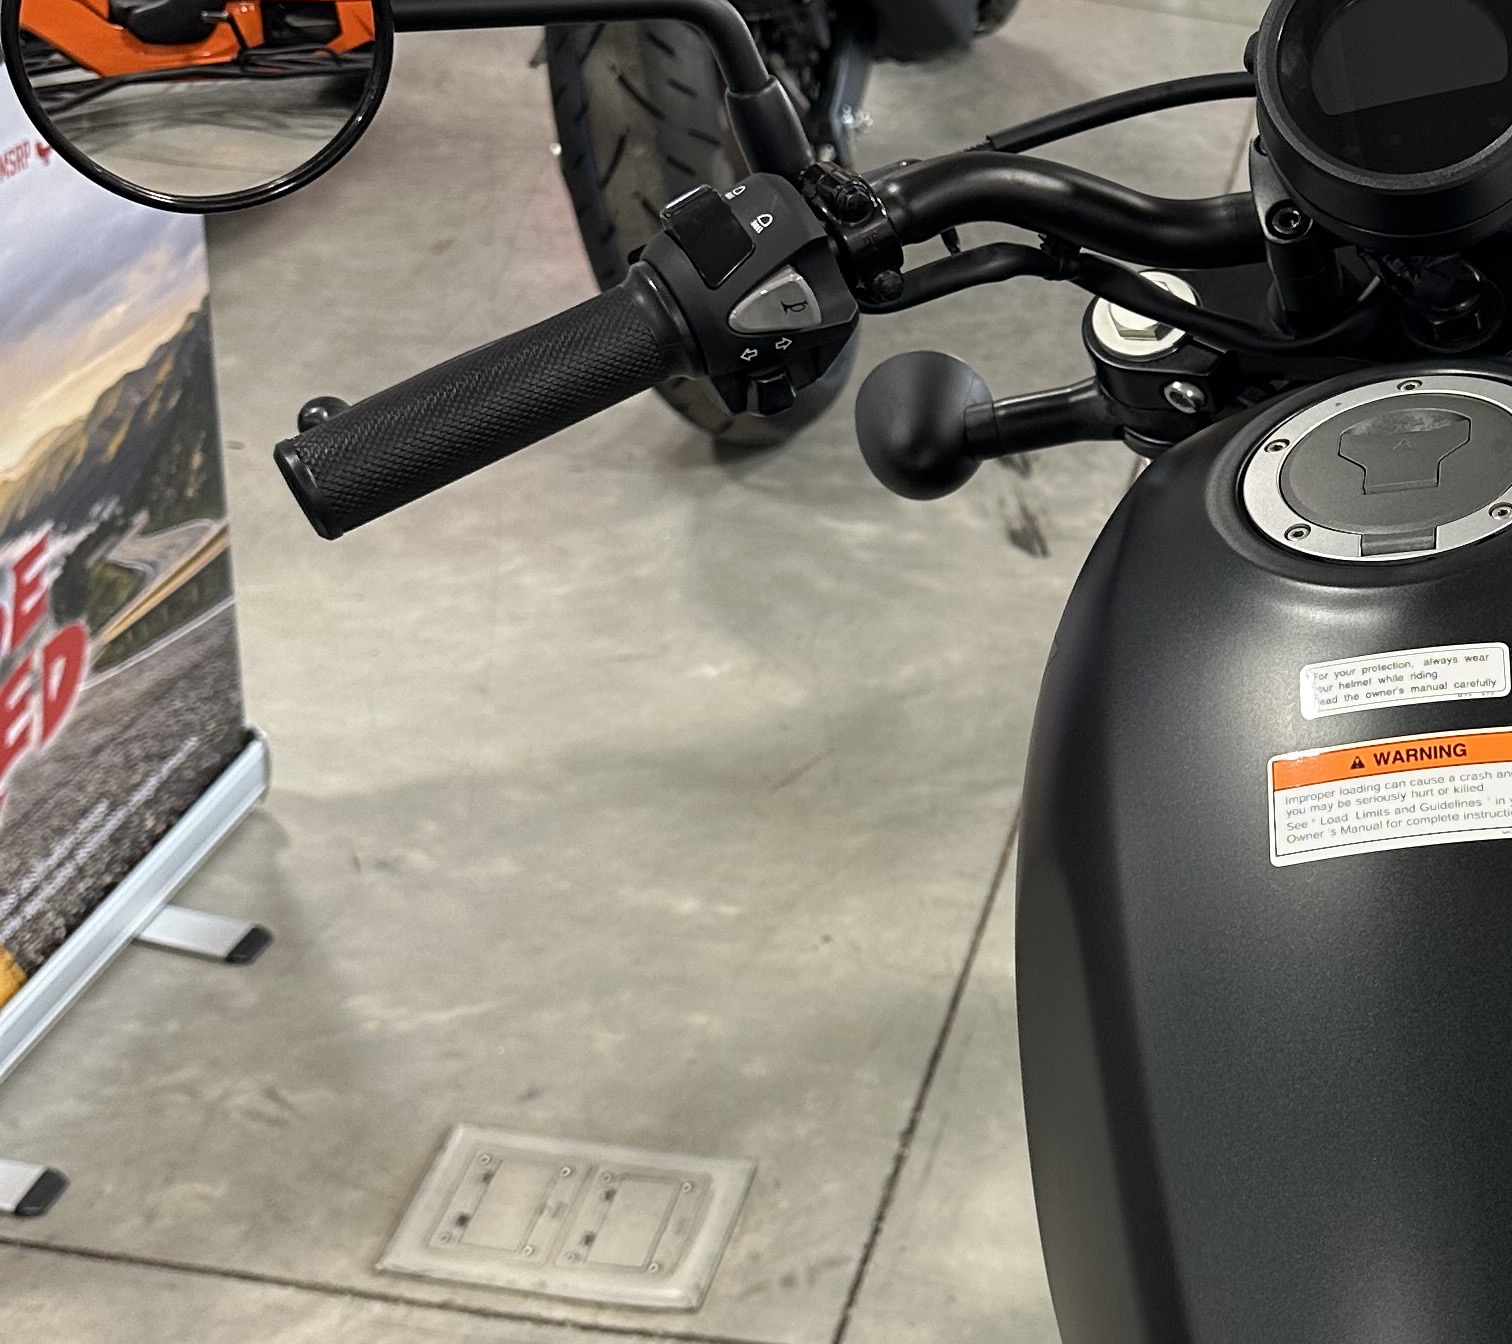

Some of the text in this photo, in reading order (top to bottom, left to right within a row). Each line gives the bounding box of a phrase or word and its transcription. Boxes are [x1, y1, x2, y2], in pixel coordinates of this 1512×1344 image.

[1313, 671, 1328, 682] For
[1334, 667, 1357, 680] your
[1424, 656, 1458, 667] always
[1464, 654, 1490, 662] wear
[1313, 684, 1333, 693] our
[1338, 678, 1372, 691] helmet
[1378, 674, 1404, 685] while
[1344, 692, 1360, 702] the
[1365, 686, 1405, 699] owner's
[1410, 682, 1448, 692] manual
[1453, 677, 1497, 690] carefully
[1373, 743, 1467, 766] WARNING
[1285, 790, 1336, 806] Improper
[1339, 782, 1381, 796] loading
[1385, 779, 1407, 790] can
[1410, 776, 1445, 787] cause
[1449, 775, 1456, 783] a
[1460, 771, 1492, 782] crash
[1286, 783, 1484, 819] you may be seriously hurt or killed
[1287, 821, 1308, 831] See
[1356, 809, 1390, 820] Limits
[1394, 804, 1416, 815] and
[1419, 798, 1482, 811] Guidelines
[1495, 796, 1506, 805] in
[1340, 823, 1383, 835] Manual
[1386, 819, 1403, 829] for
[1406, 813, 1460, 826] complete
